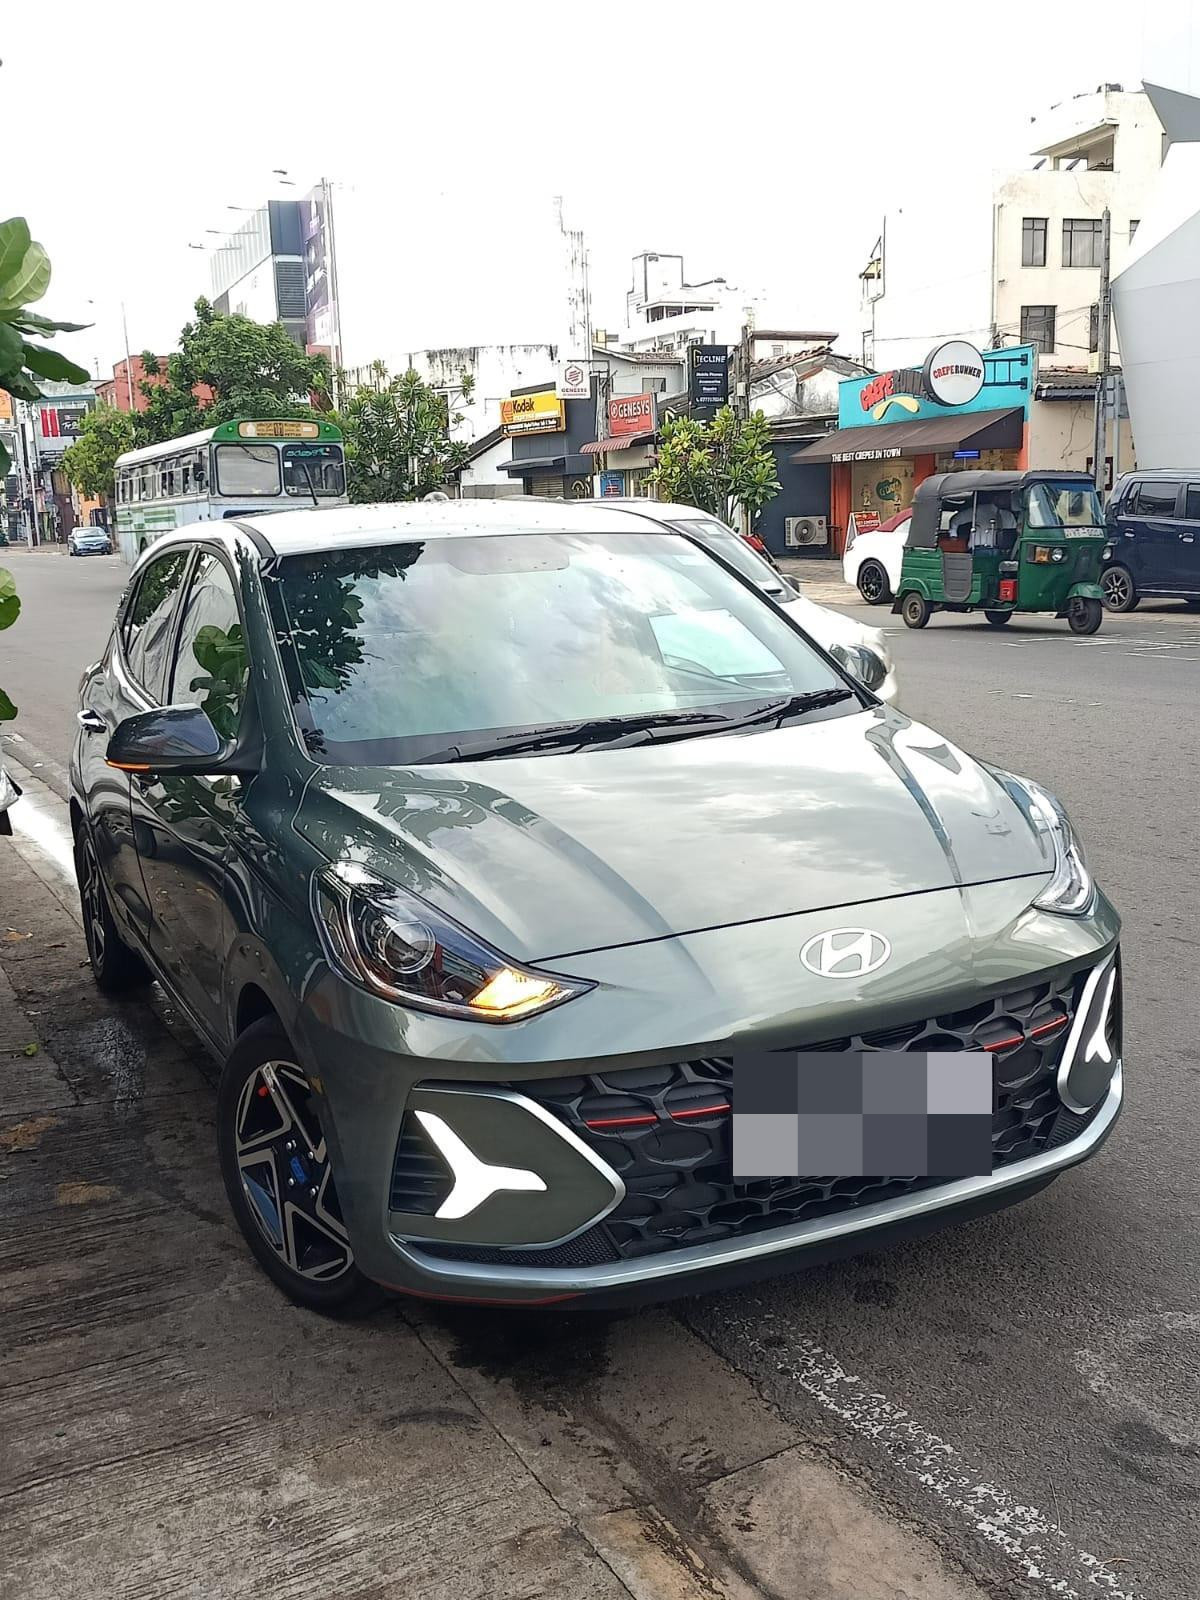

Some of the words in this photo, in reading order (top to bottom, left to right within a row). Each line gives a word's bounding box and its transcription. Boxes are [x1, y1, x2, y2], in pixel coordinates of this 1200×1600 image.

[696, 355, 726, 363] TECLINE
[860, 369, 895, 412] CREPE
[512, 398, 535, 413] Kodak
[618, 399, 650, 418] GENESYS
[831, 453, 842, 462] THE
[842, 452, 855, 462] BEST
[855, 450, 875, 460] CREPES
[875, 449, 883, 459] IN
[883, 447, 902, 458] TOWN
